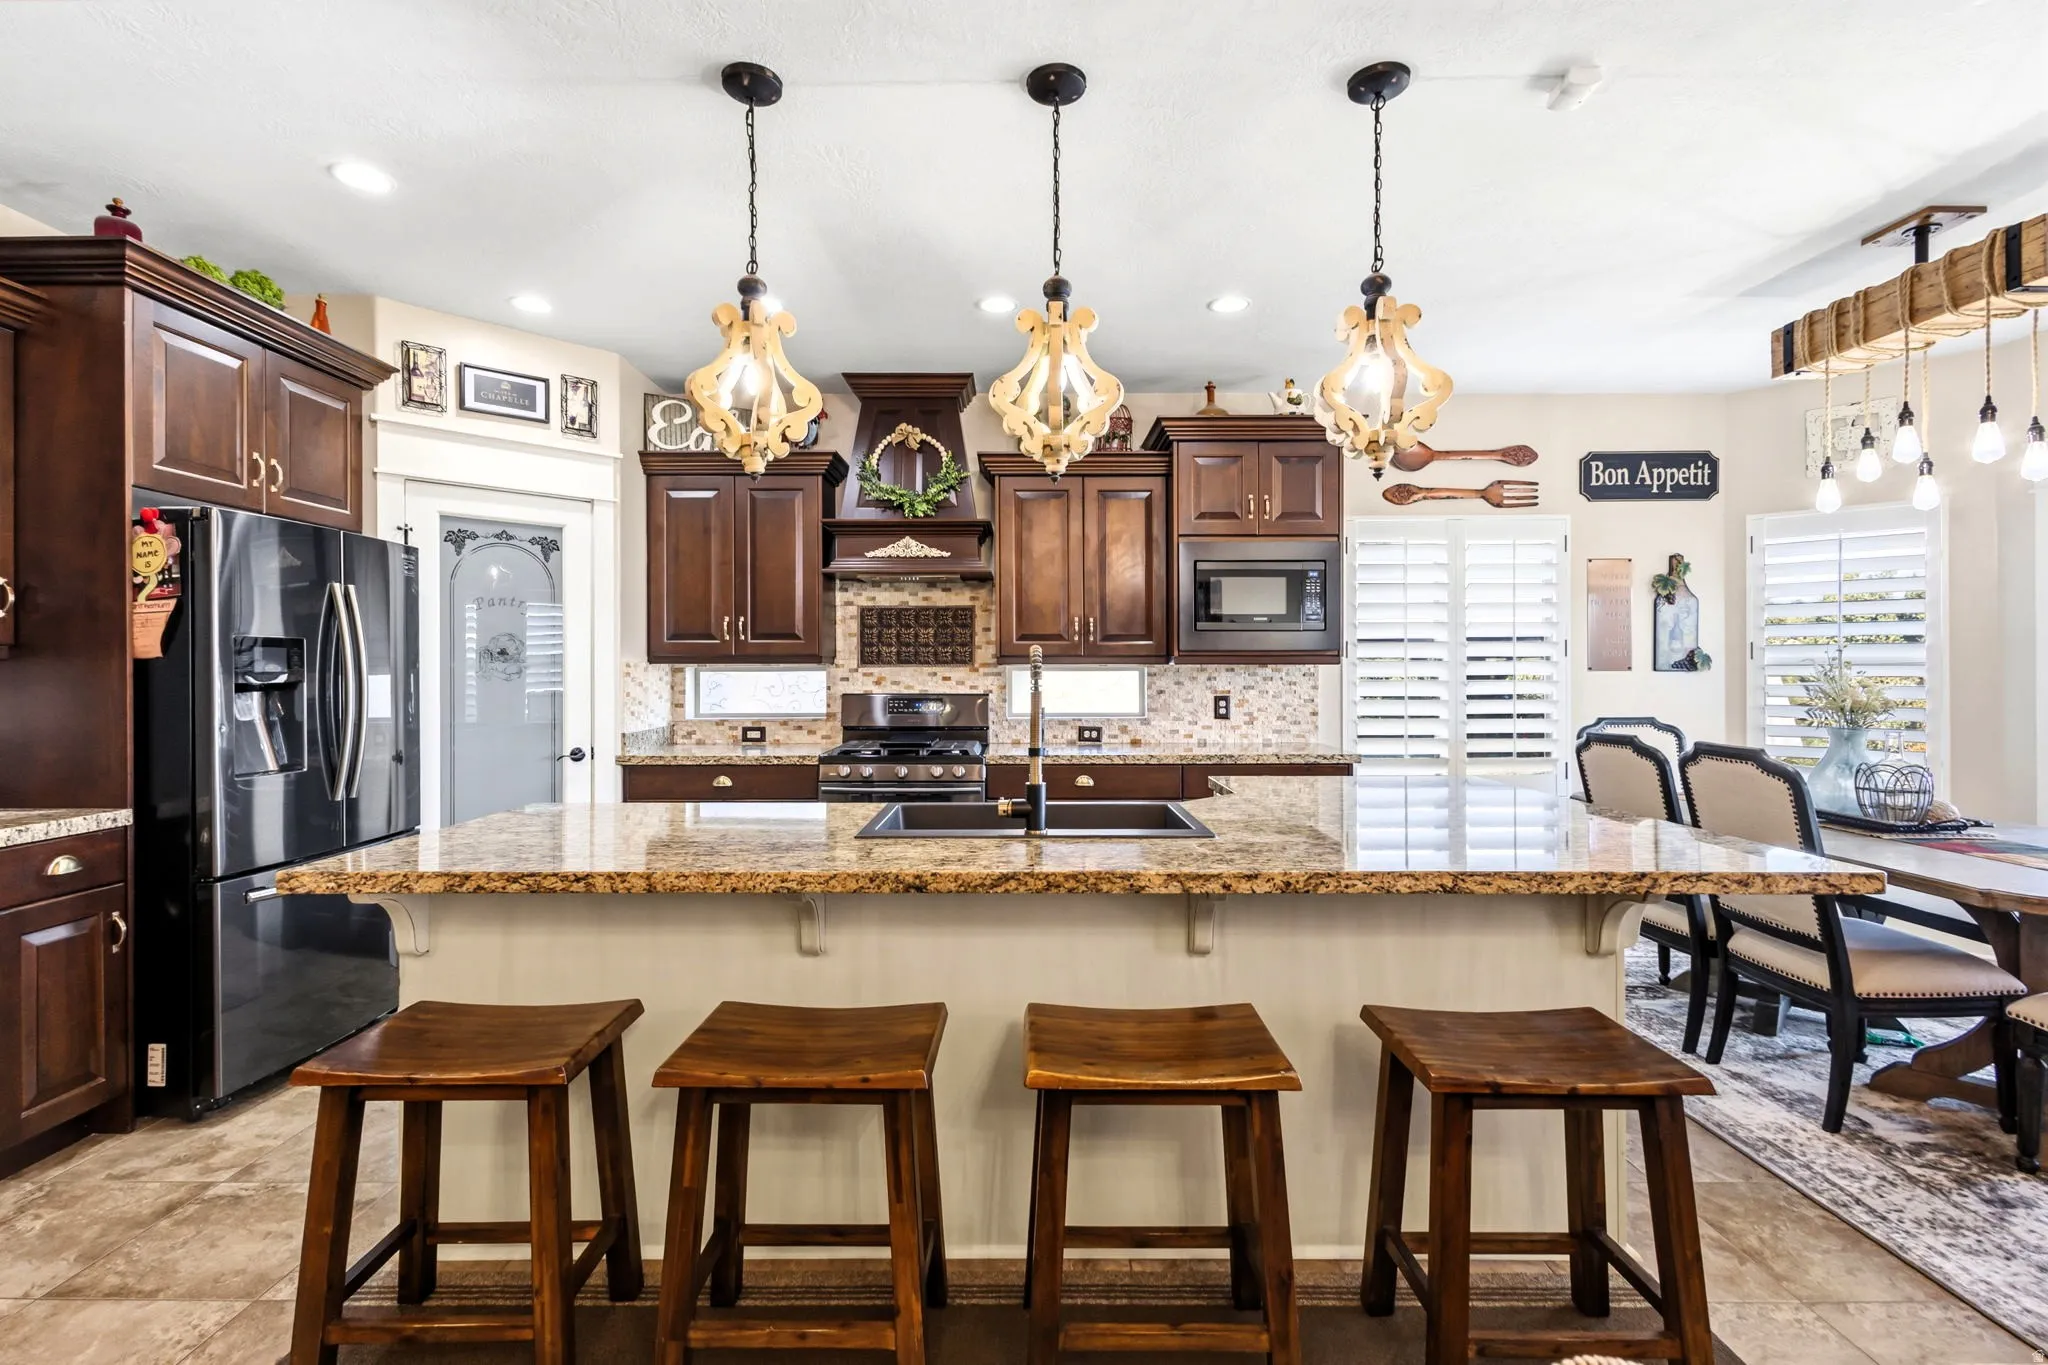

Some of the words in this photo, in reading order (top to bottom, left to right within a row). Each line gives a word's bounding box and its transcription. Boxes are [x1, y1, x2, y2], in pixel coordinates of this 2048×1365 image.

[480, 391, 530, 407] CHAPELLE
[1589, 461, 1630, 487] Bon
[1634, 460, 1712, 493] Appetit
[136, 550, 160, 559] NAME
